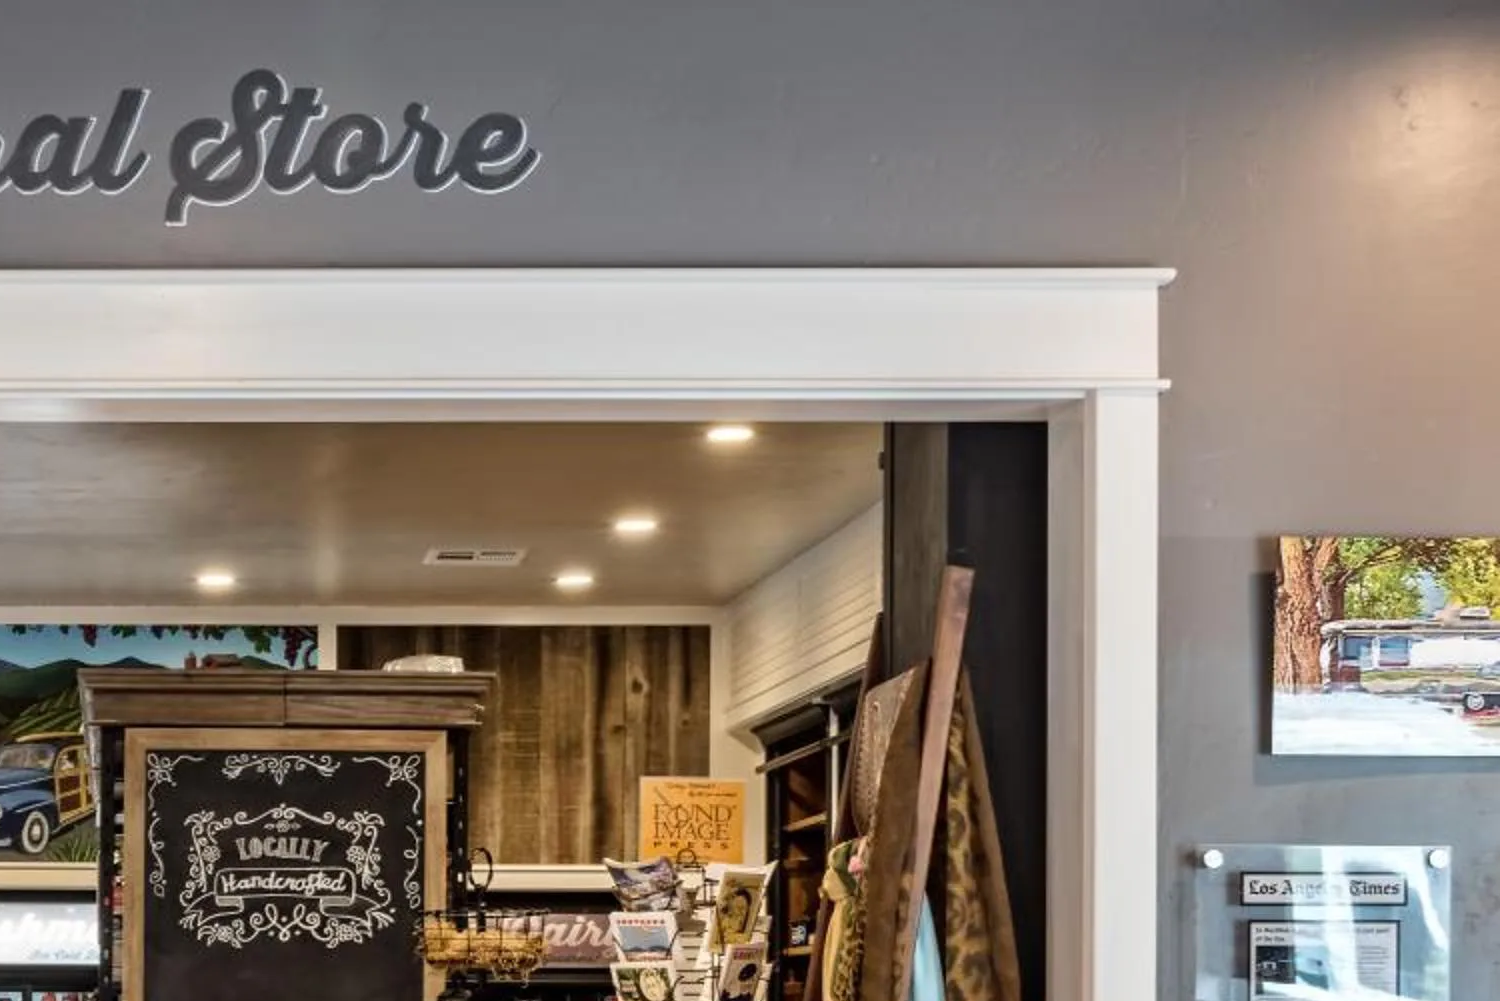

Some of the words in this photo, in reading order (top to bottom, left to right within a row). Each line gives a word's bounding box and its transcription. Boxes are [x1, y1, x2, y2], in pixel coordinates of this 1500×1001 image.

[165, 68, 540, 228] Store
[234, 837, 329, 863] LOCALLY
[220, 871, 346, 896] Handcrafted
[1249, 879, 1277, 895] Los
[1349, 879, 1401, 897] Times
